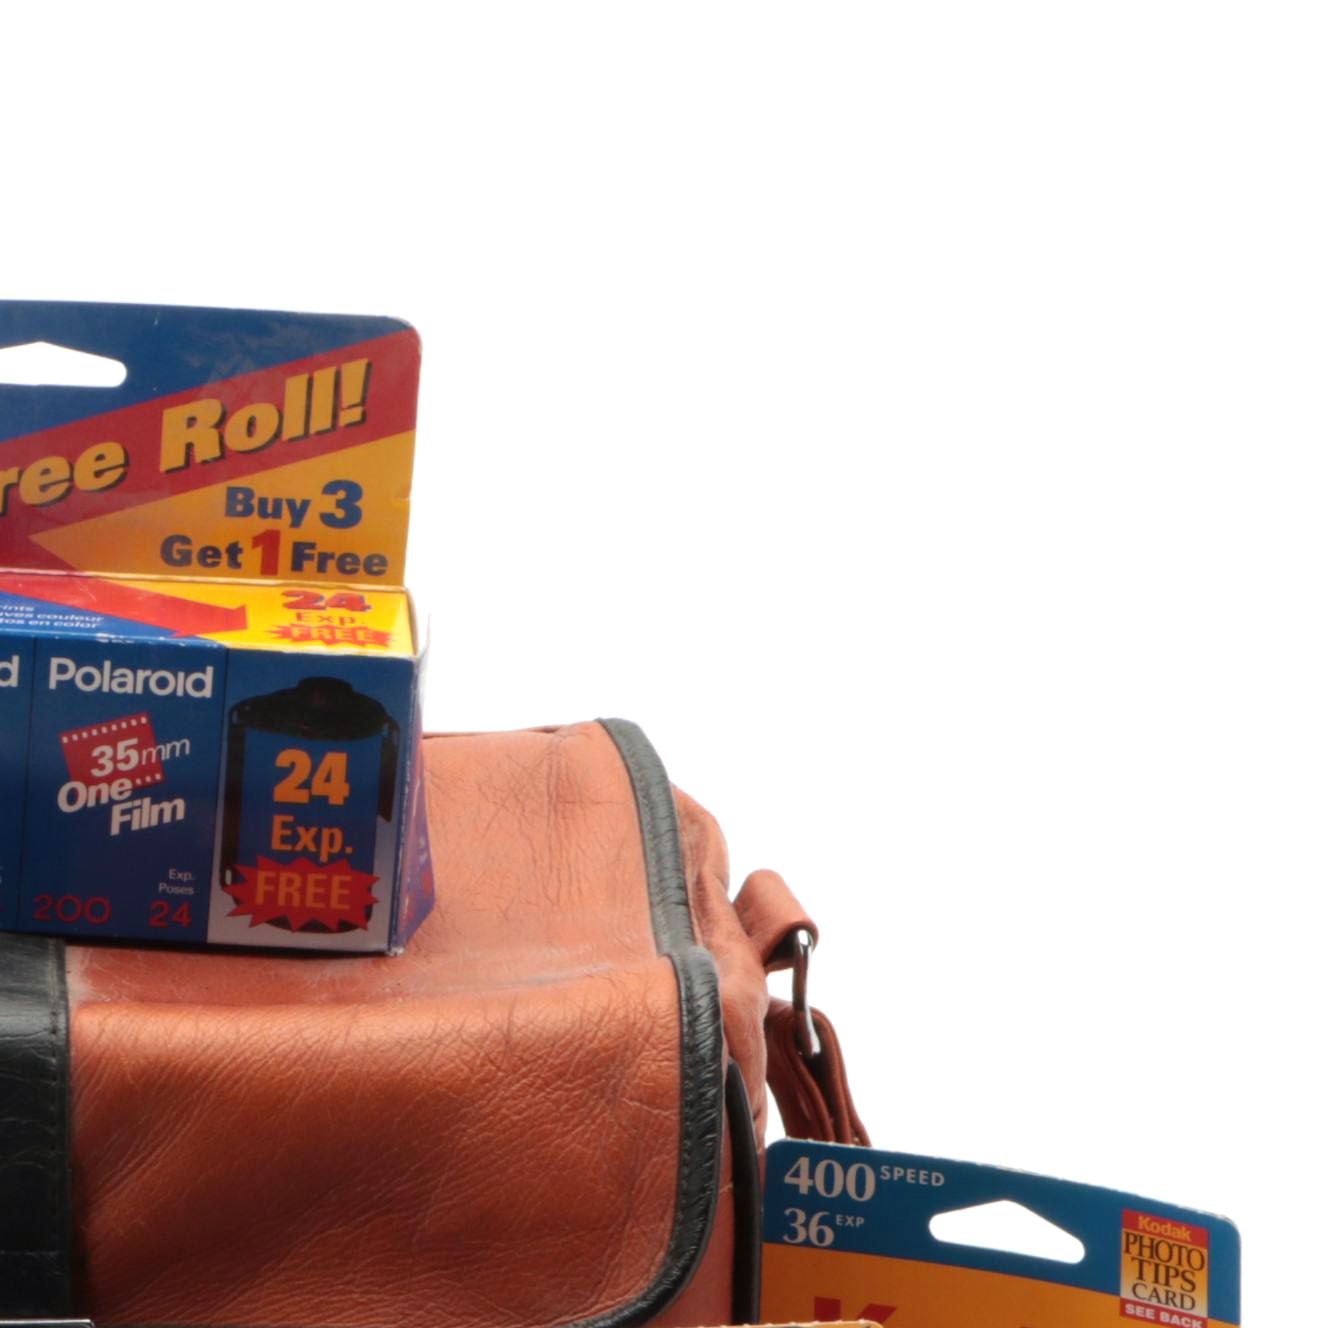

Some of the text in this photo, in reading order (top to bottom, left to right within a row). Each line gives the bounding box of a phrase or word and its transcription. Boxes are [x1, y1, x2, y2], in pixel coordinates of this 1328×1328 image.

[159, 358, 370, 474] Roll!
[225, 480, 364, 529] Buy 3
[160, 529, 388, 577] Get 1 Free
[37, 612, 105, 622] couleur
[282, 590, 371, 612] 24
[295, 612, 366, 626] Exp.
[53, 619, 100, 628] color
[292, 626, 371, 643] FREE
[49, 656, 213, 698] Polaroid
[90, 736, 190, 777] 35mm
[57, 776, 132, 813] One
[273, 748, 350, 806] 24
[111, 796, 185, 836] Film
[271, 815, 353, 863] Exp.
[159, 882, 194, 895] Poses
[169, 868, 194, 882] Exp.
[255, 870, 353, 912] FREE
[32, 894, 192, 928] 200 24
[784, 1156, 945, 1202] 400 SPEED
[783, 1208, 865, 1247] 36 EXP
[1138, 1215, 1192, 1242] Kodak
[1123, 1231, 1206, 1272] PHOTO
[1131, 1256, 1197, 1293] TIPS
[1125, 1303, 1155, 1320] SEE
[1132, 1282, 1196, 1311] CARD
